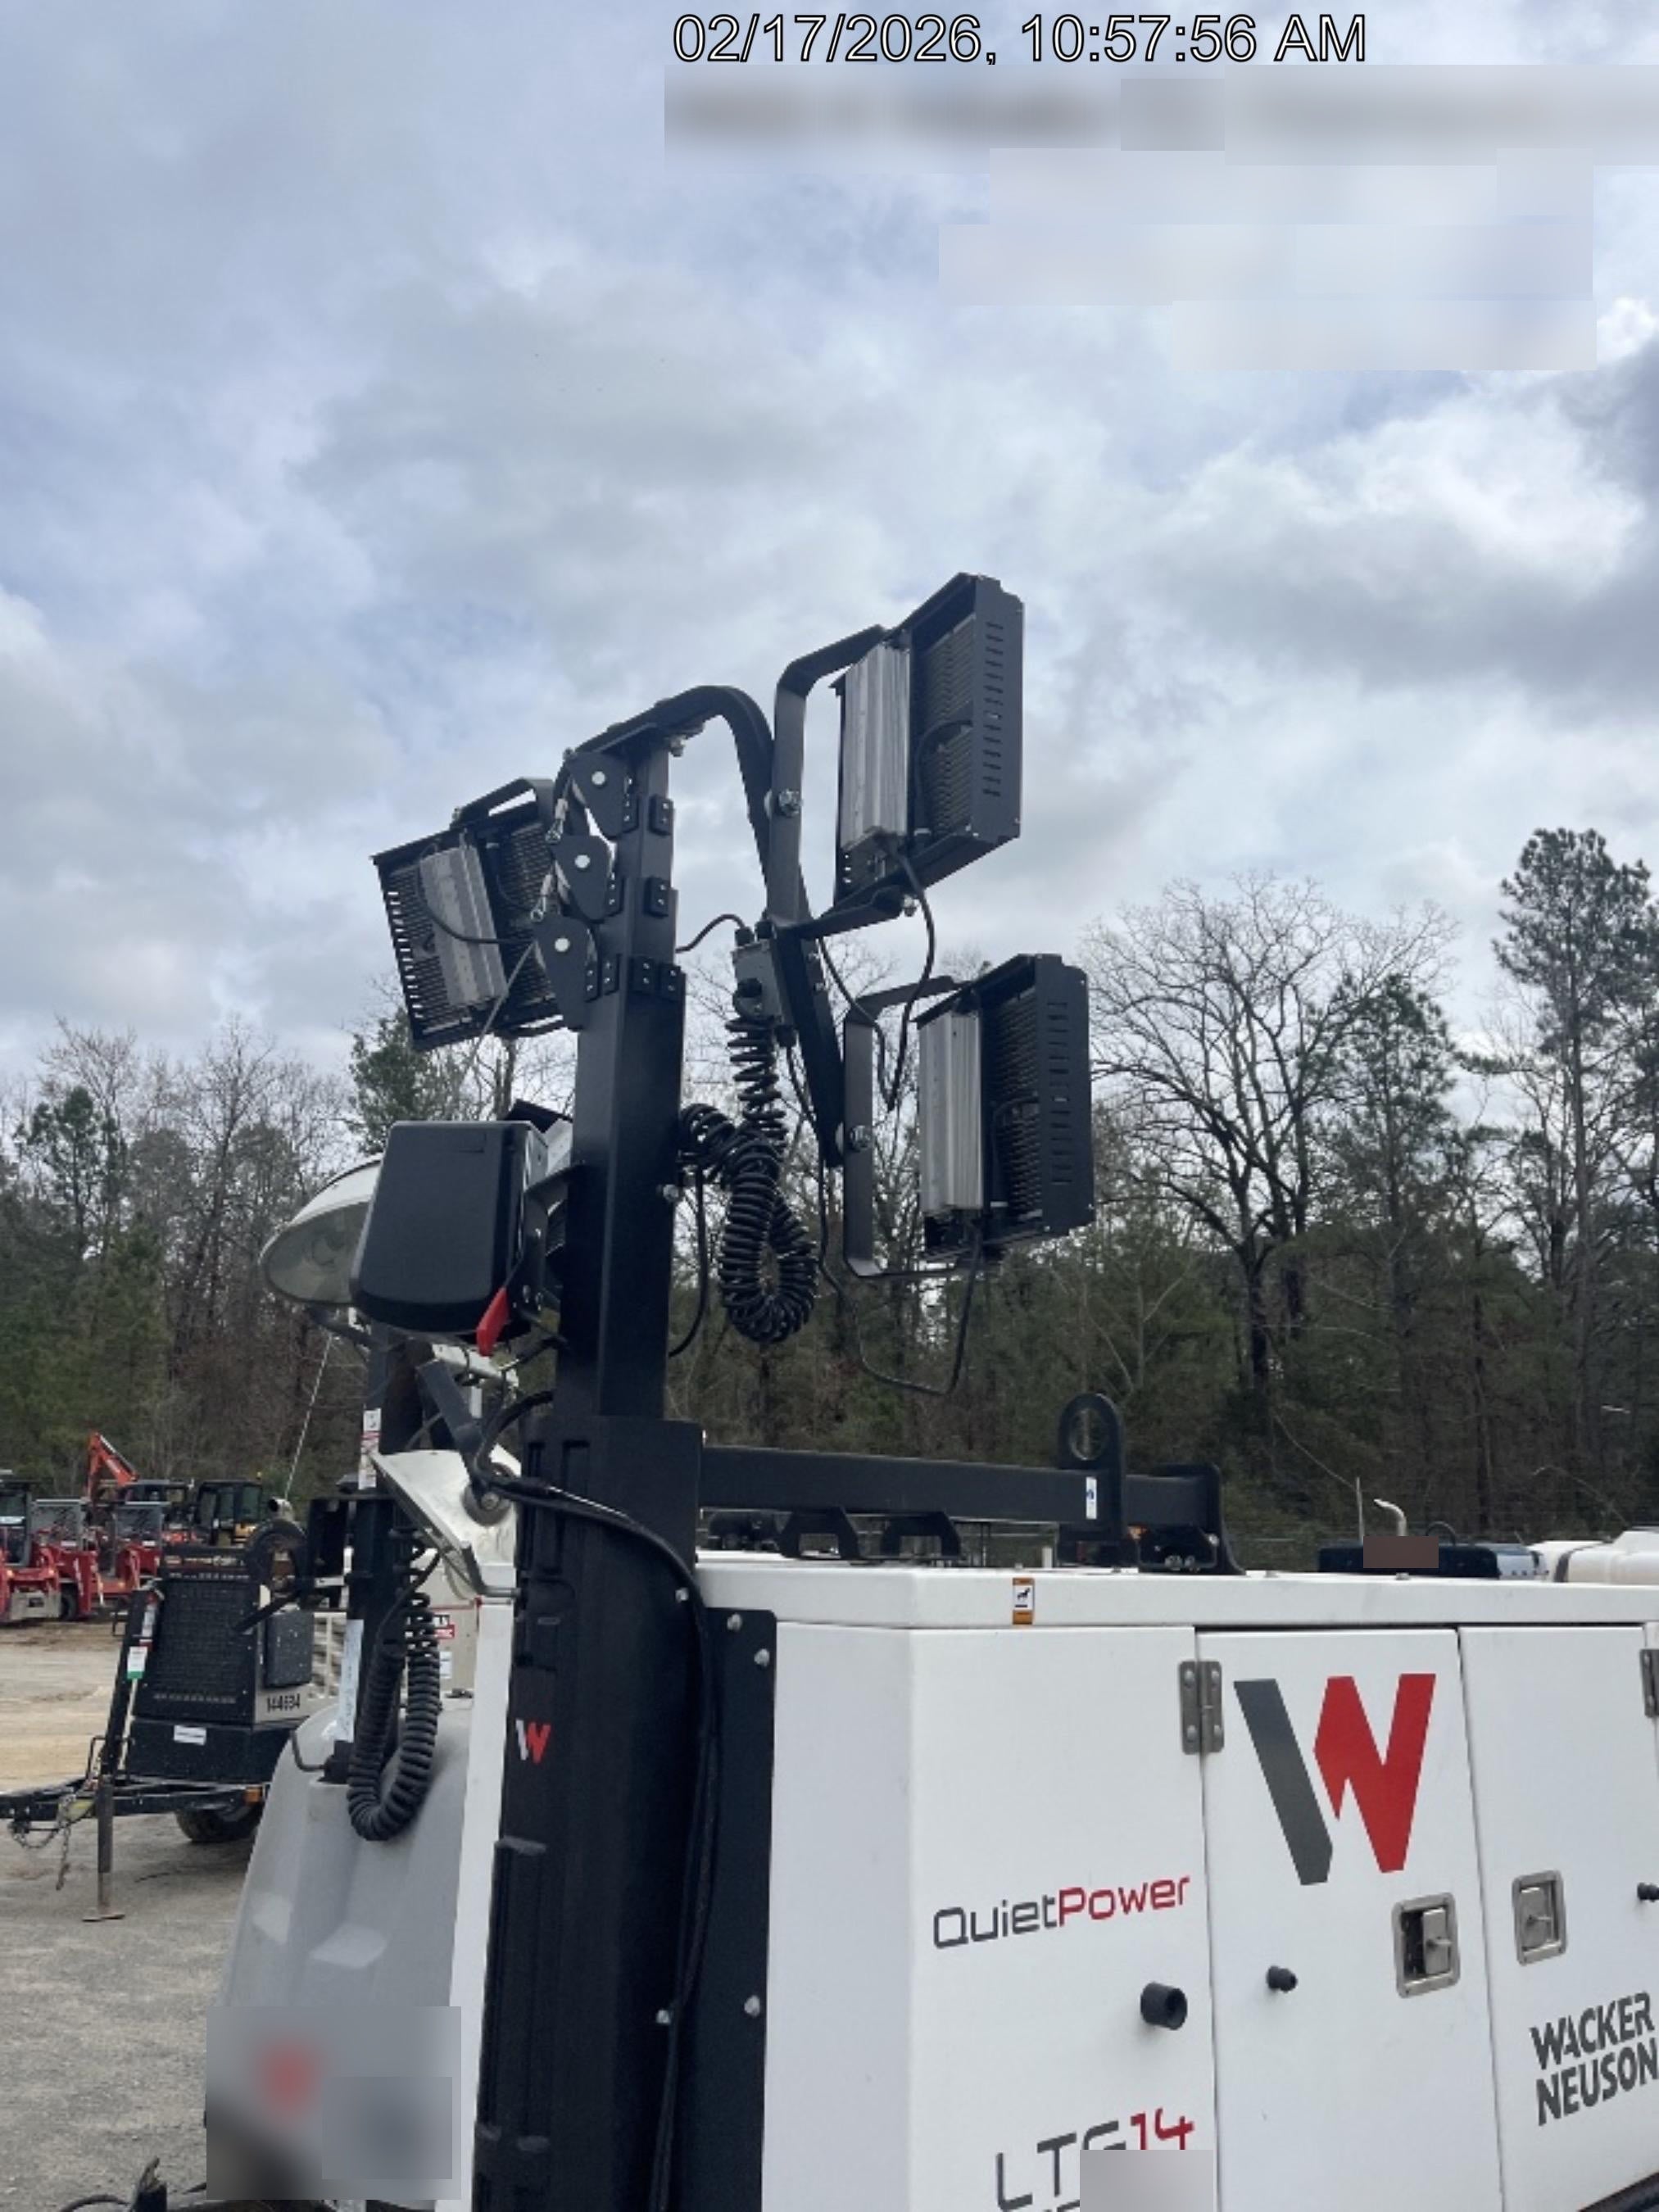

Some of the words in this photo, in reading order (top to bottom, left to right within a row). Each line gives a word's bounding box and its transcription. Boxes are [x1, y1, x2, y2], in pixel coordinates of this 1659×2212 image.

[933, 1874, 1191, 1949] QuietPower
[1529, 1991, 1656, 2070] WACKER
[1535, 2037, 1659, 2127] NEUSON
